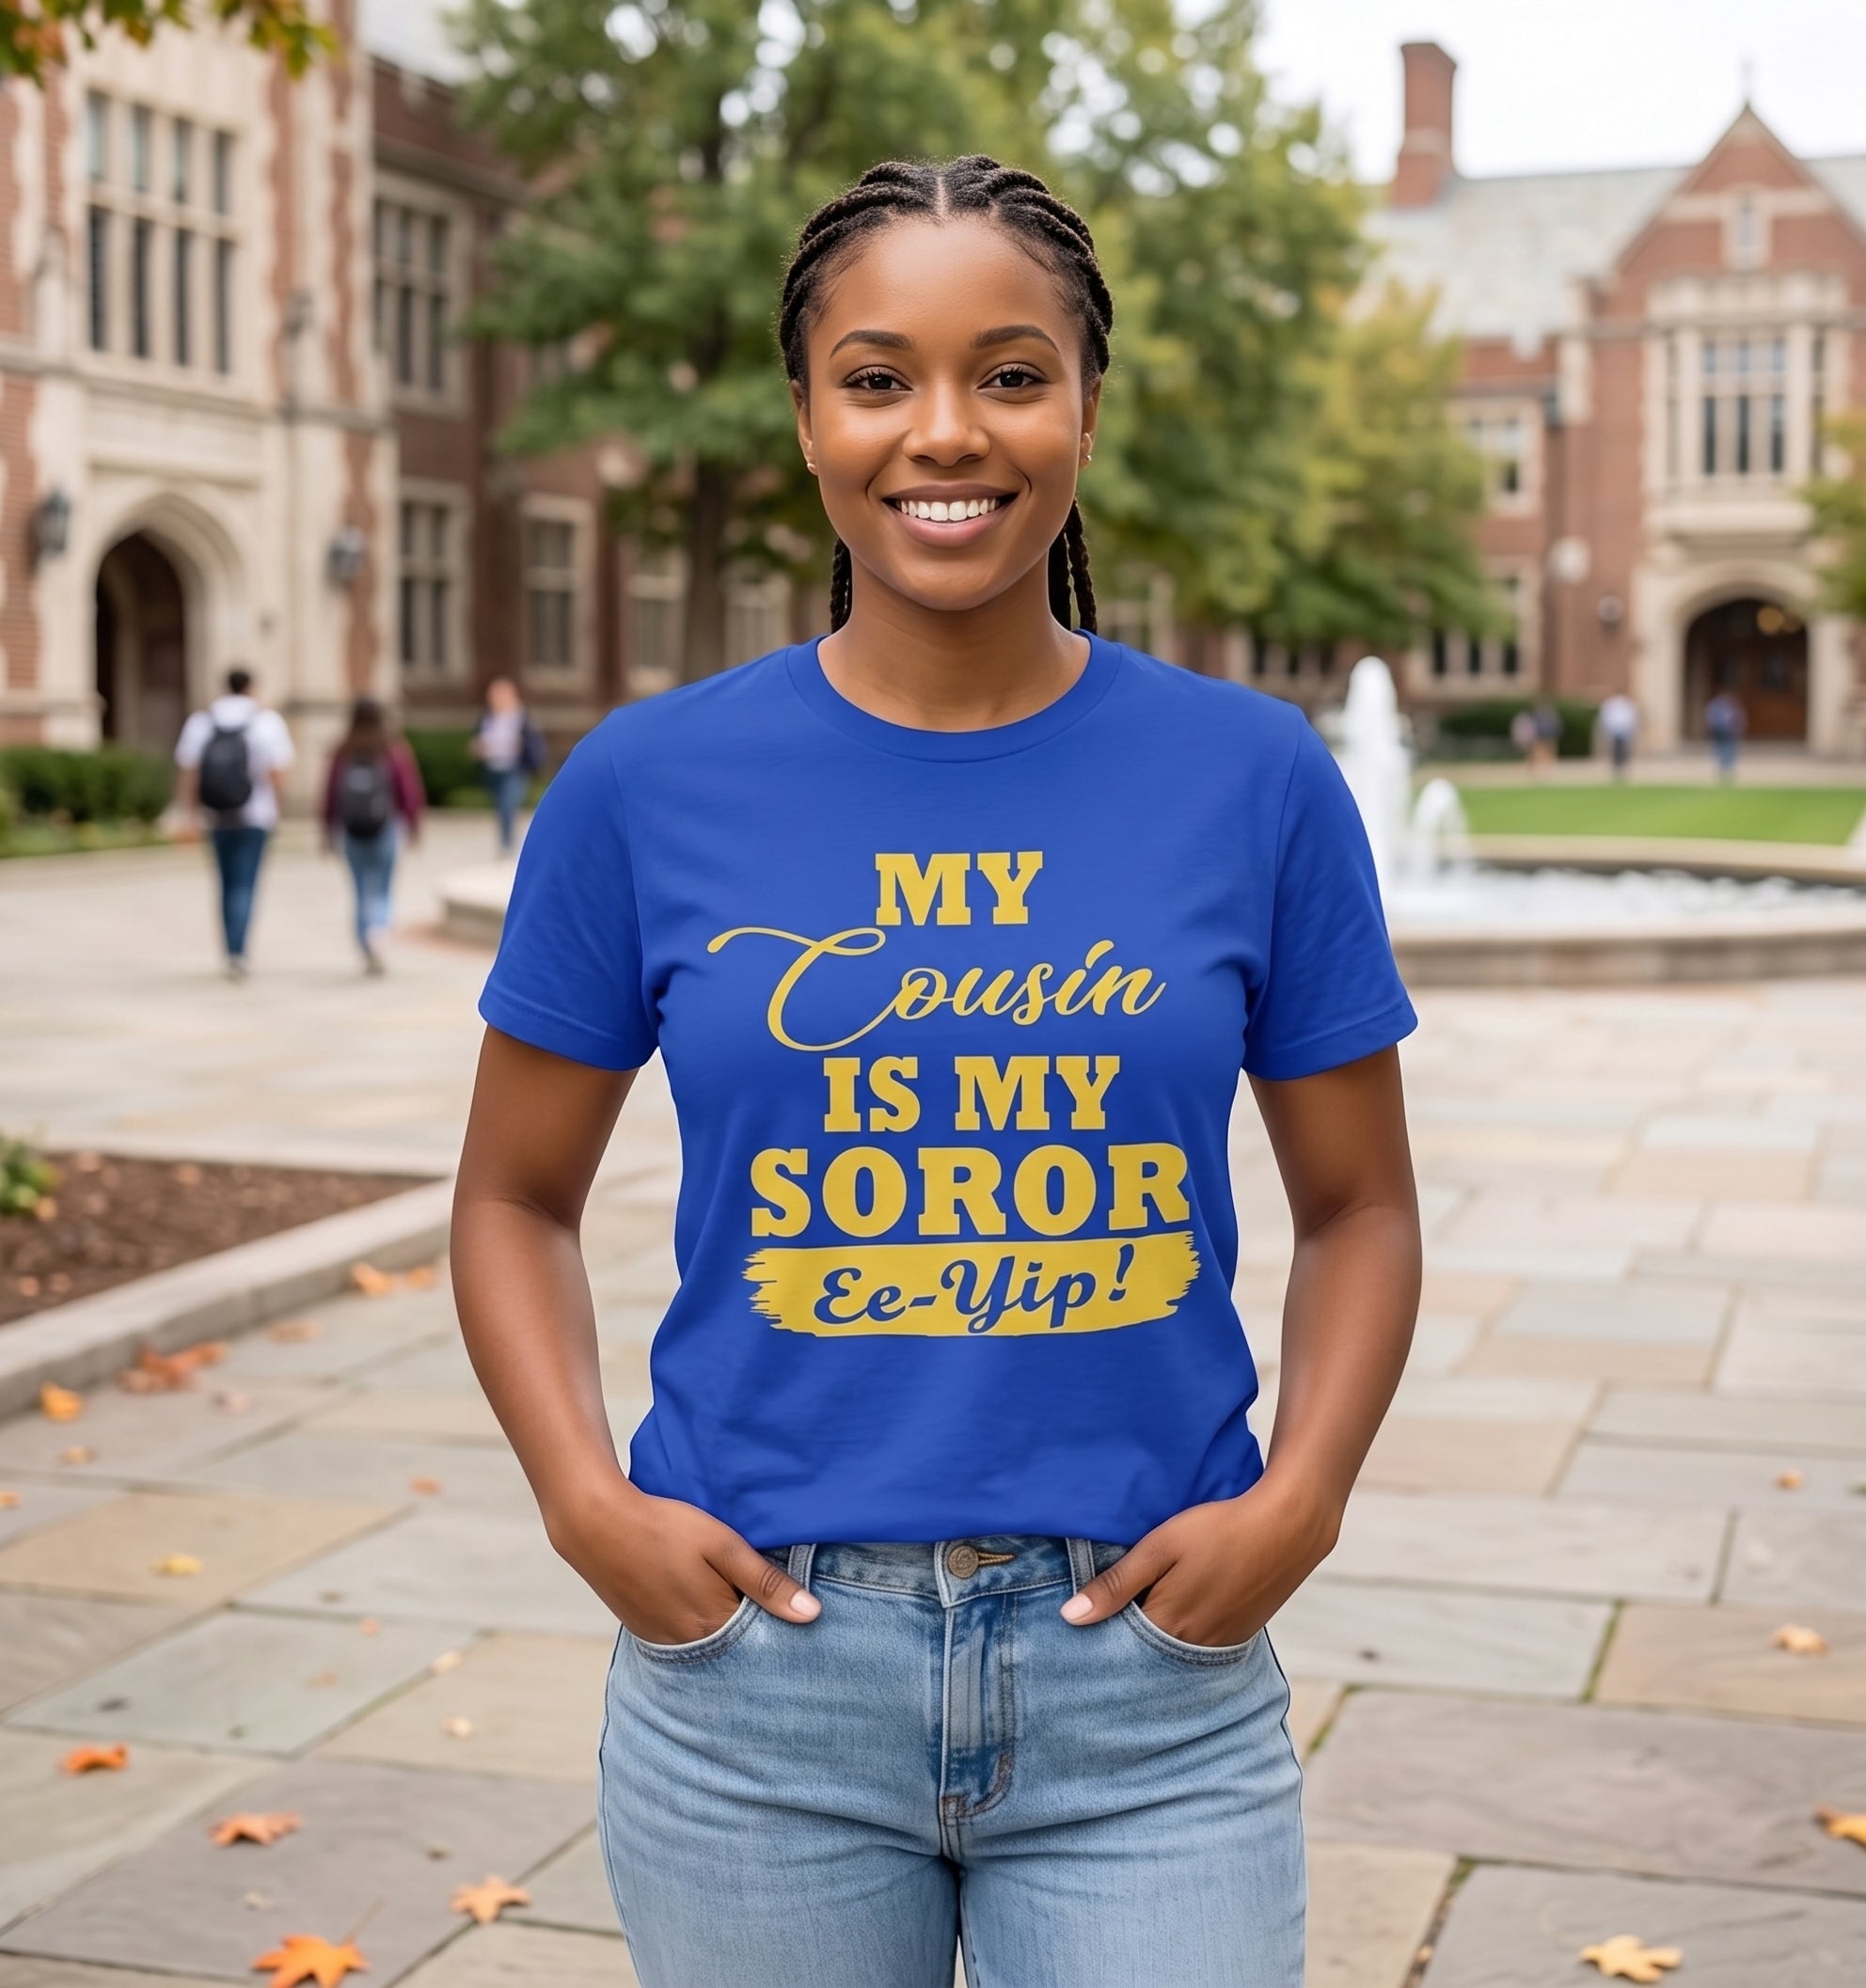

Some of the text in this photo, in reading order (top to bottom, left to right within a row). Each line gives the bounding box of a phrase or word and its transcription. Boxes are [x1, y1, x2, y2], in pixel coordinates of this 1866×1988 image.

[876, 851, 1043, 925] MY
[707, 926, 1166, 1051] Cousin
[823, 1055, 1120, 1132] IS MY
[750, 1143, 1191, 1237] SOROR
[813, 1243, 1134, 1333] Ee-Yip!
